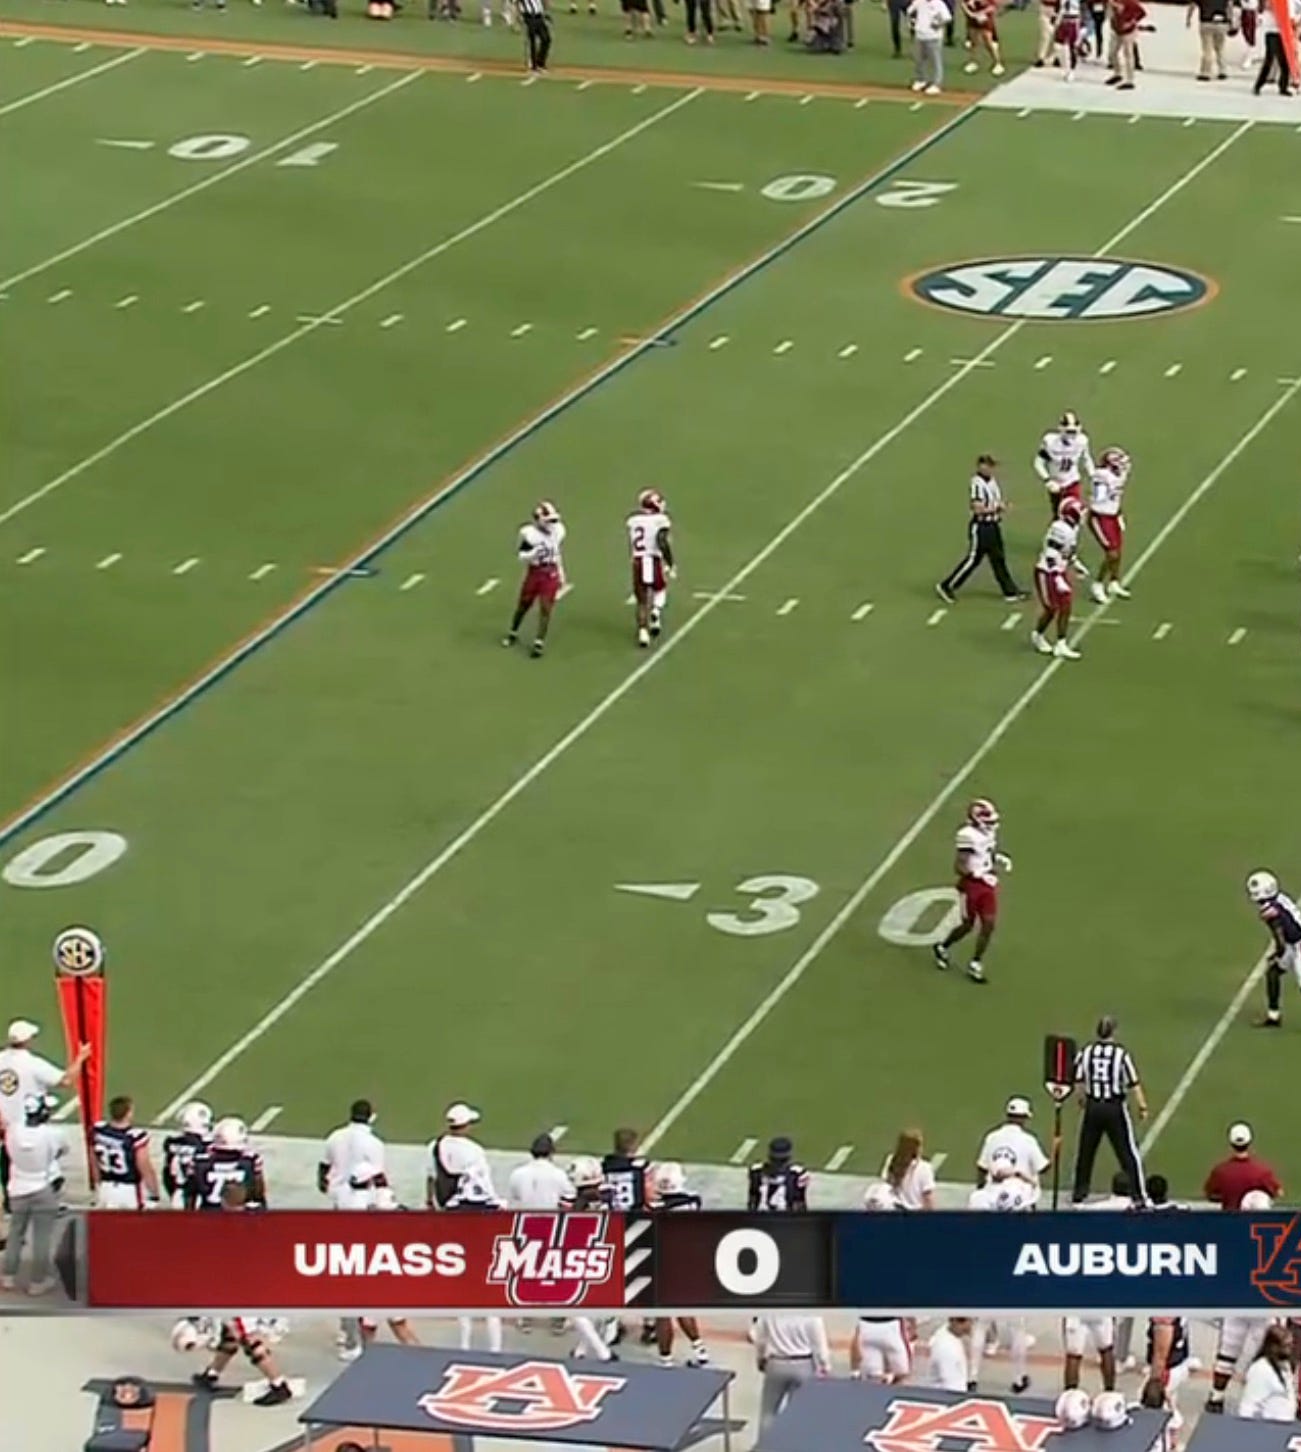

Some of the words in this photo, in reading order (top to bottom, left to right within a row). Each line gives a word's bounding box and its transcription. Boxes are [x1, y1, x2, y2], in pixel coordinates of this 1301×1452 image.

[928, 259, 1194, 318] SEC
[632, 525, 646, 552] 2
[1092, 1058, 1112, 1081] H
[94, 1144, 129, 1175] 33
[758, 1184, 788, 1211] 14
